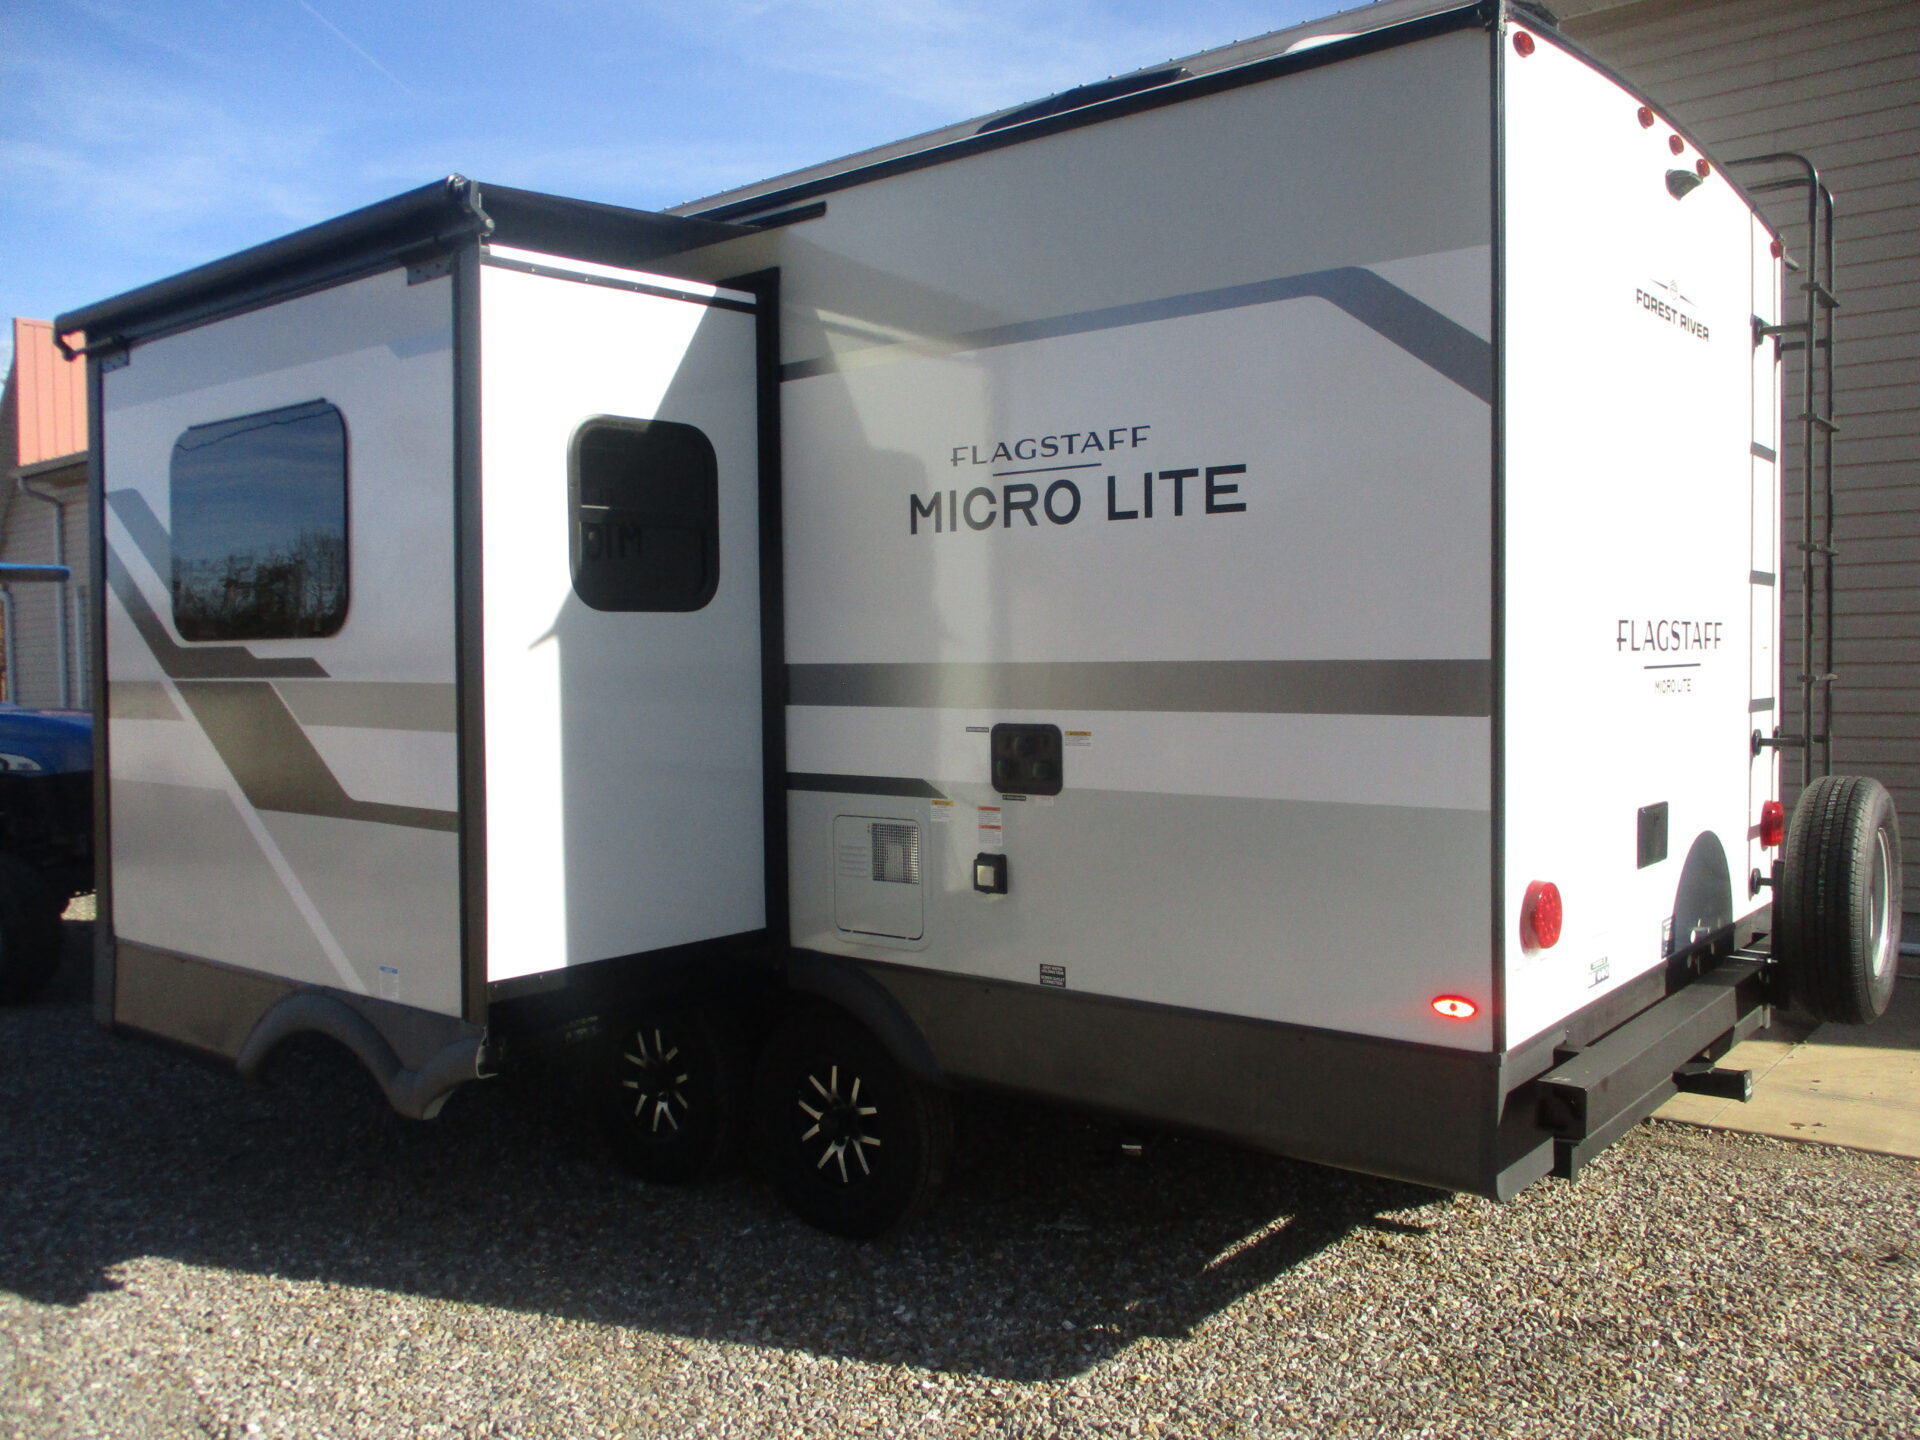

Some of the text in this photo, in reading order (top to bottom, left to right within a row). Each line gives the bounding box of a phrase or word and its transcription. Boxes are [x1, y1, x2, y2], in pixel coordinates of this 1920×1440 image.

[1636, 288, 1709, 342] FOREST RIVER
[951, 425, 1151, 467] FLAGSTAFF
[910, 464, 1247, 535] MICRO LITE
[1617, 620, 1722, 651] FLAGSTAFF
[1655, 679, 1676, 694] MICRO
